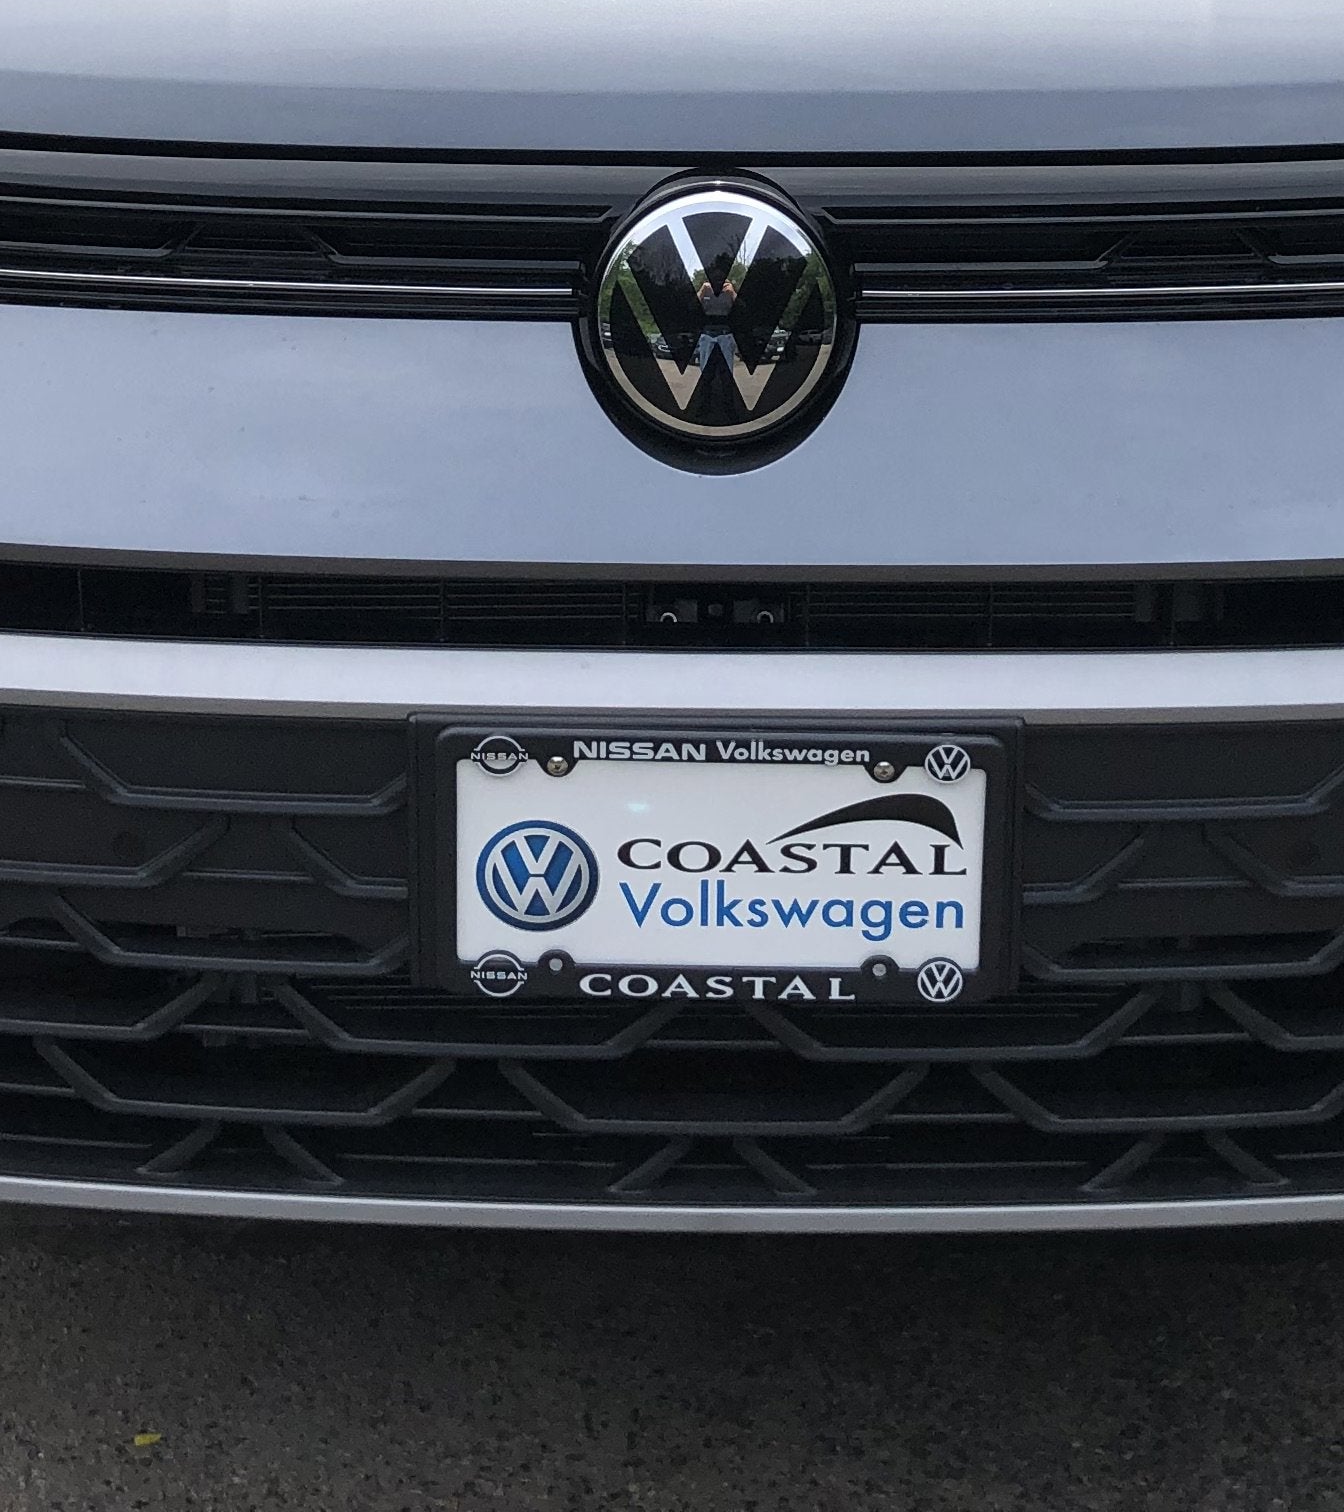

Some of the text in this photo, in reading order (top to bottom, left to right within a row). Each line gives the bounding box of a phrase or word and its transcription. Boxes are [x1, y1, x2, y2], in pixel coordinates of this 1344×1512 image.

[470, 751, 529, 761] NISSAN
[572, 738, 870, 766] NISSAN Volkswagen
[617, 838, 967, 876] COASTAL
[619, 879, 964, 942] Volkswagen
[470, 970, 528, 981] NISSAN
[579, 973, 856, 1000] COASTAL
